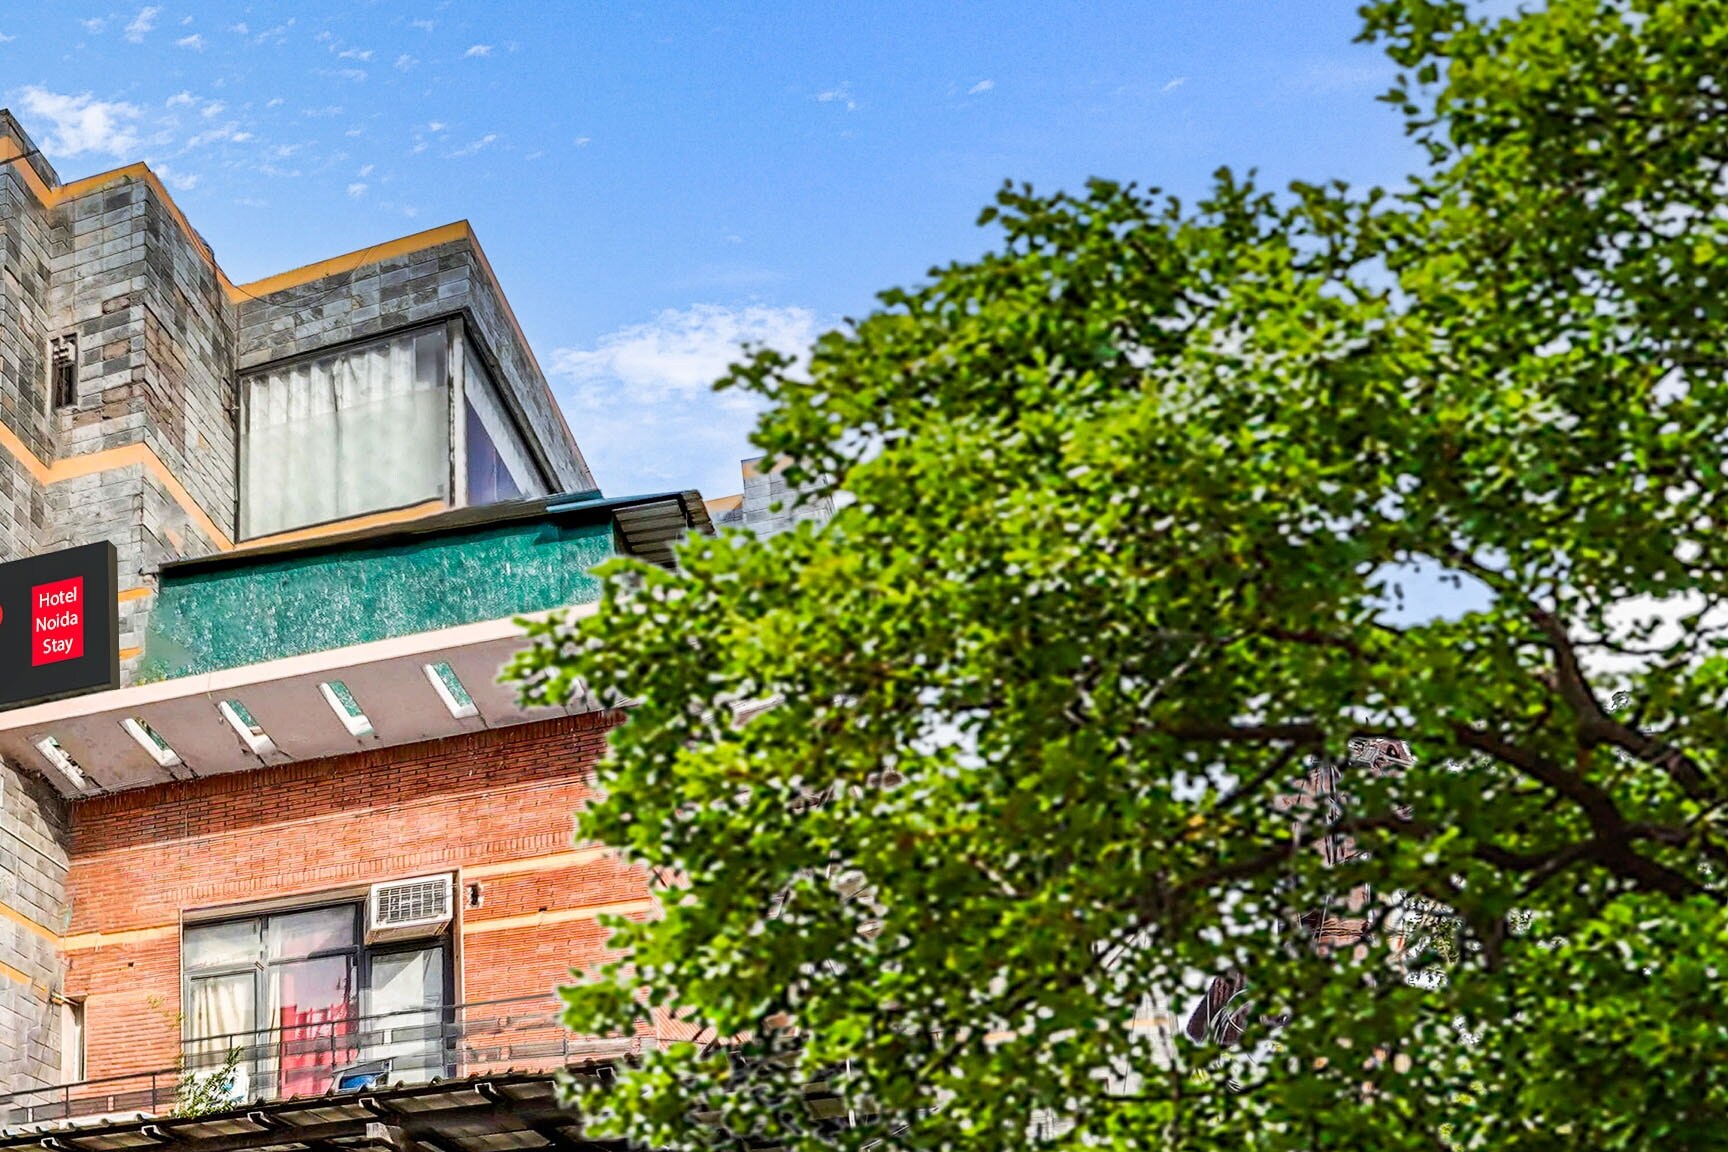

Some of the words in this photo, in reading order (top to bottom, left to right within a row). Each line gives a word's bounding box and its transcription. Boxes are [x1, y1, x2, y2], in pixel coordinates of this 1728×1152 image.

[39, 586, 77, 608] Hotel
[36, 610, 78, 633] Noida
[43, 638, 73, 654] Stay
